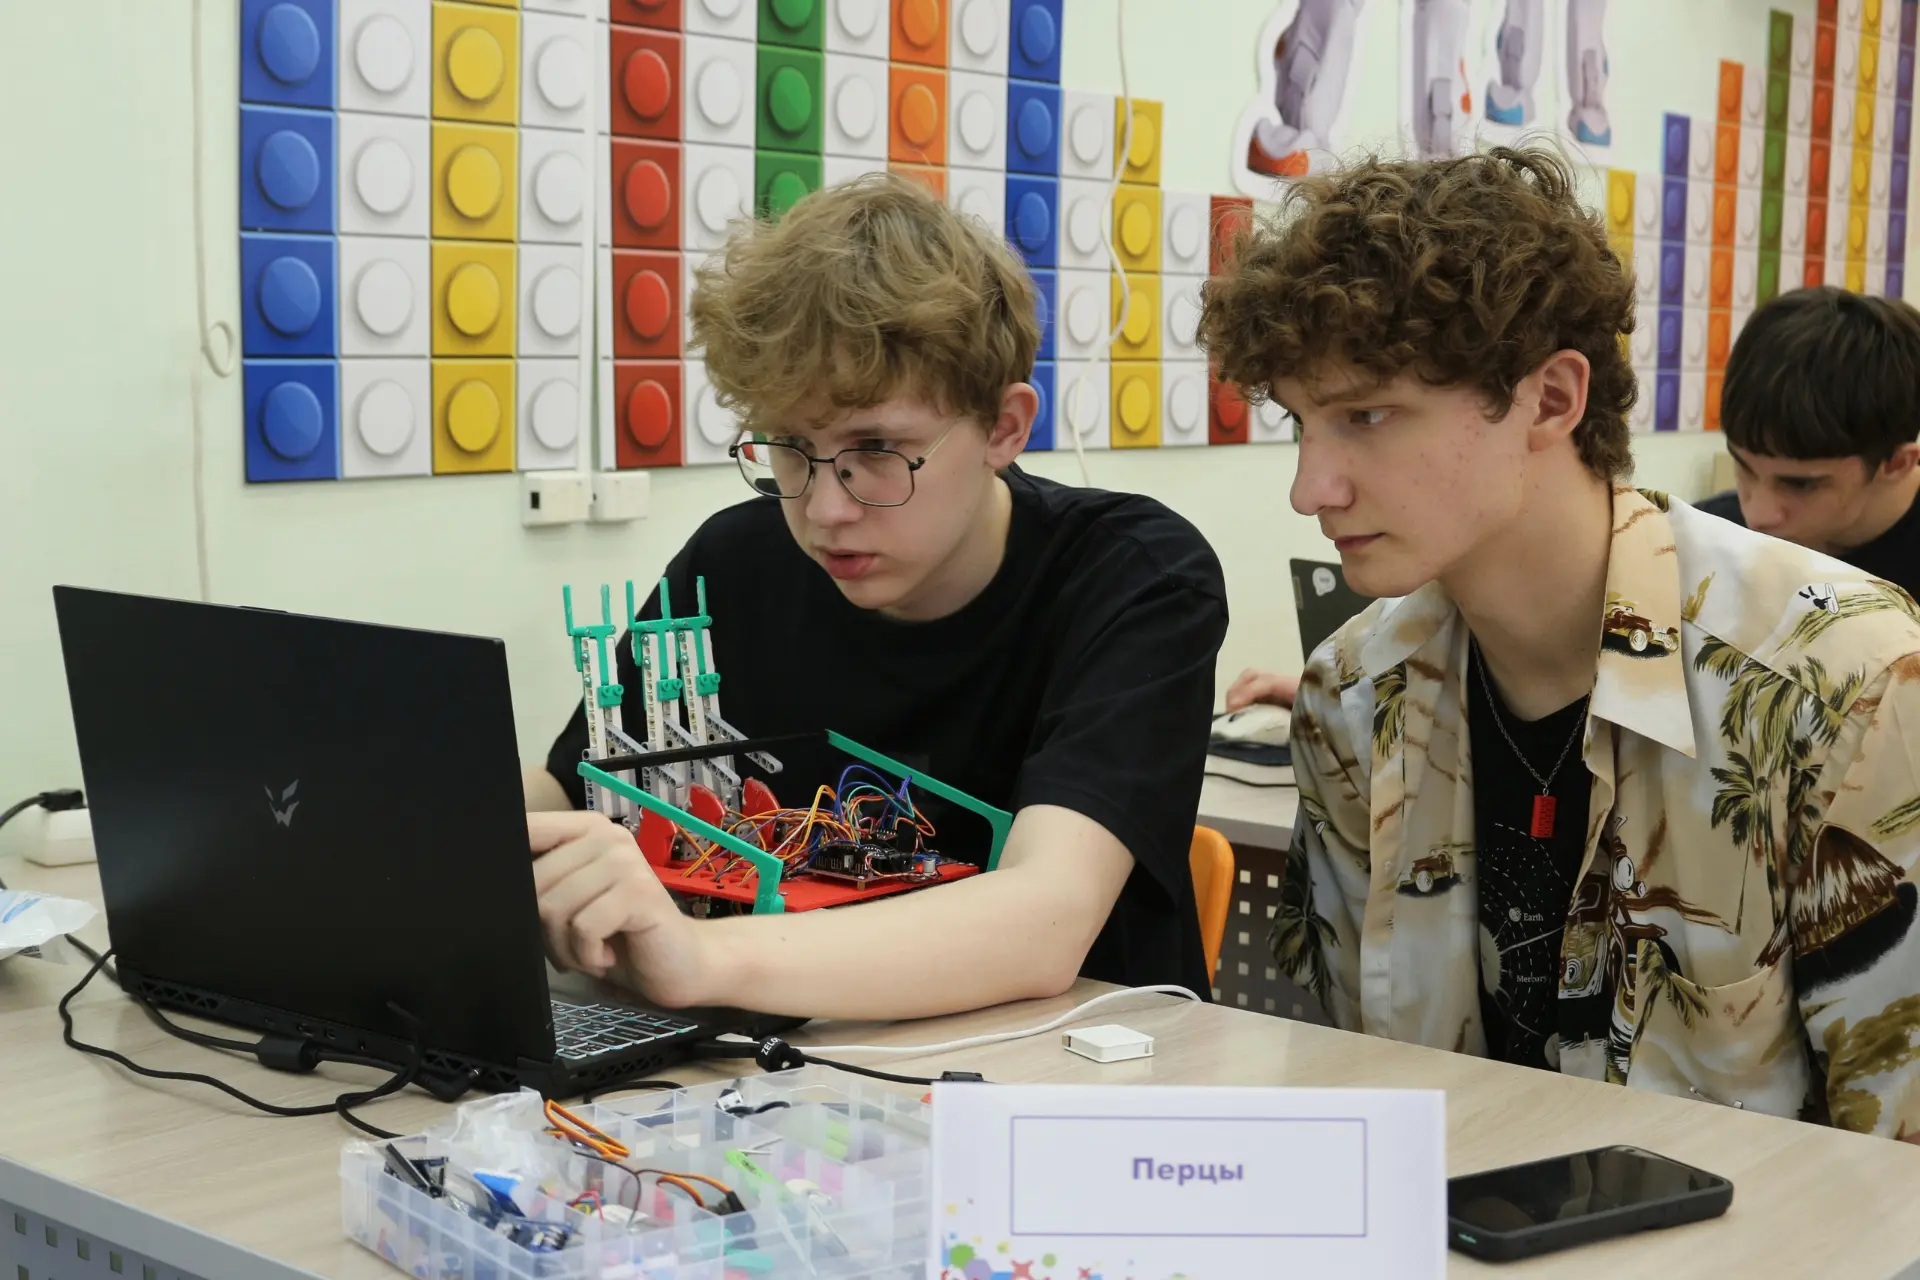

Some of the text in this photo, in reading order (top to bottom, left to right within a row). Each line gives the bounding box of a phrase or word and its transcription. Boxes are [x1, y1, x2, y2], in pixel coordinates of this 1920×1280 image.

[1523, 912, 1544, 922] Earth
[1516, 974, 1547, 983] Mercury
[1132, 1157, 1244, 1187] Перцы
